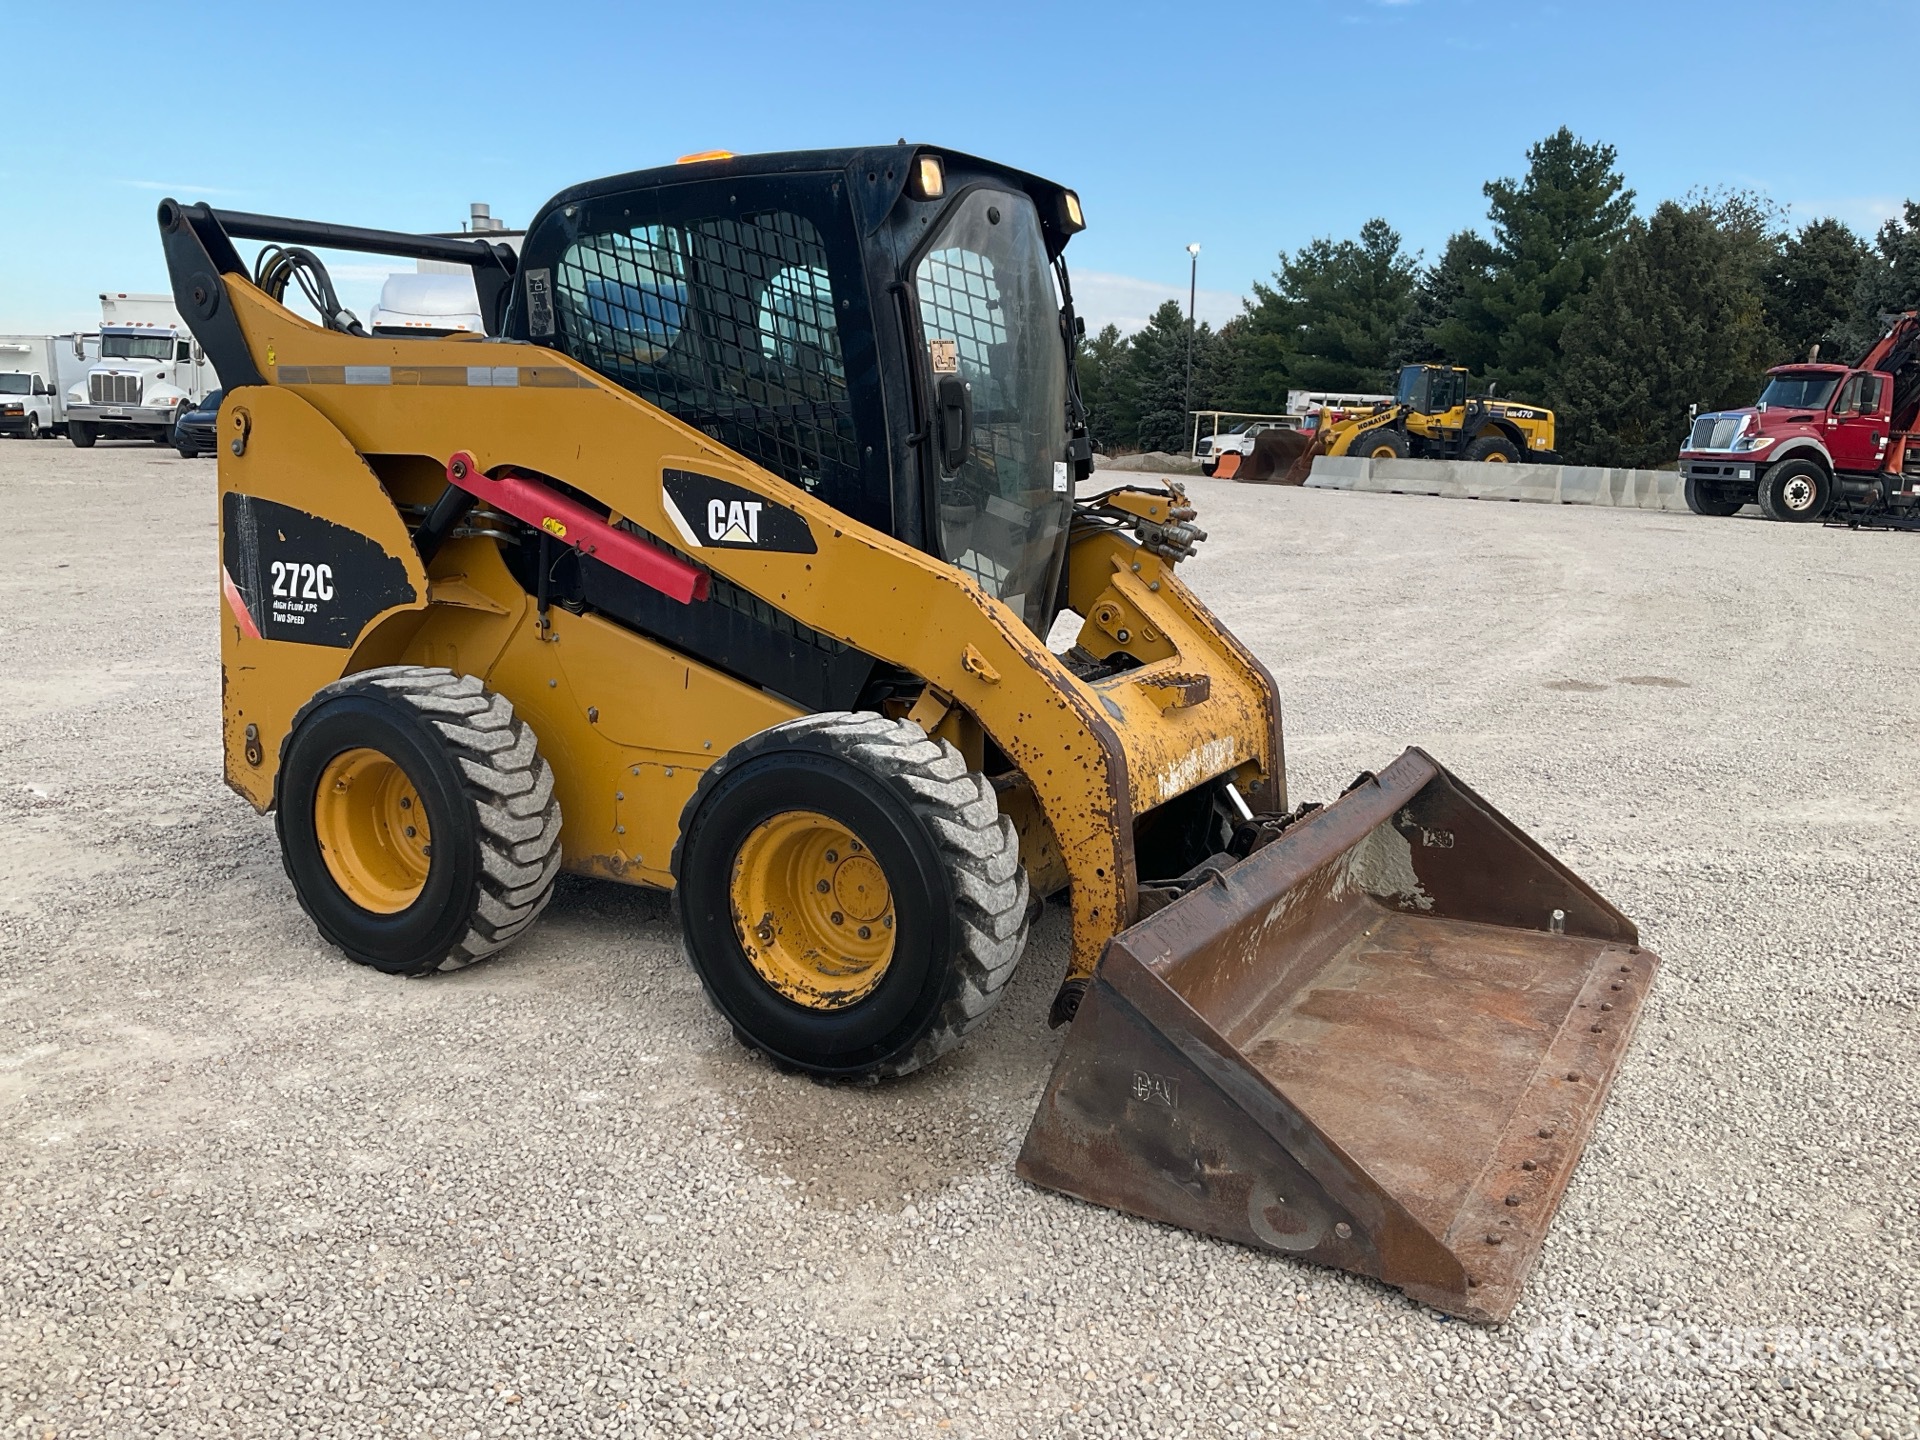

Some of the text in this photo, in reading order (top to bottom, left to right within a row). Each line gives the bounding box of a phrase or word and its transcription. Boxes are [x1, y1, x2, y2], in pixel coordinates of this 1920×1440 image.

[1357, 412, 1392, 431] KOMATSU
[707, 498, 762, 543] CAT
[271, 561, 334, 600] 272C
[1132, 1069, 1181, 1109] CAT
